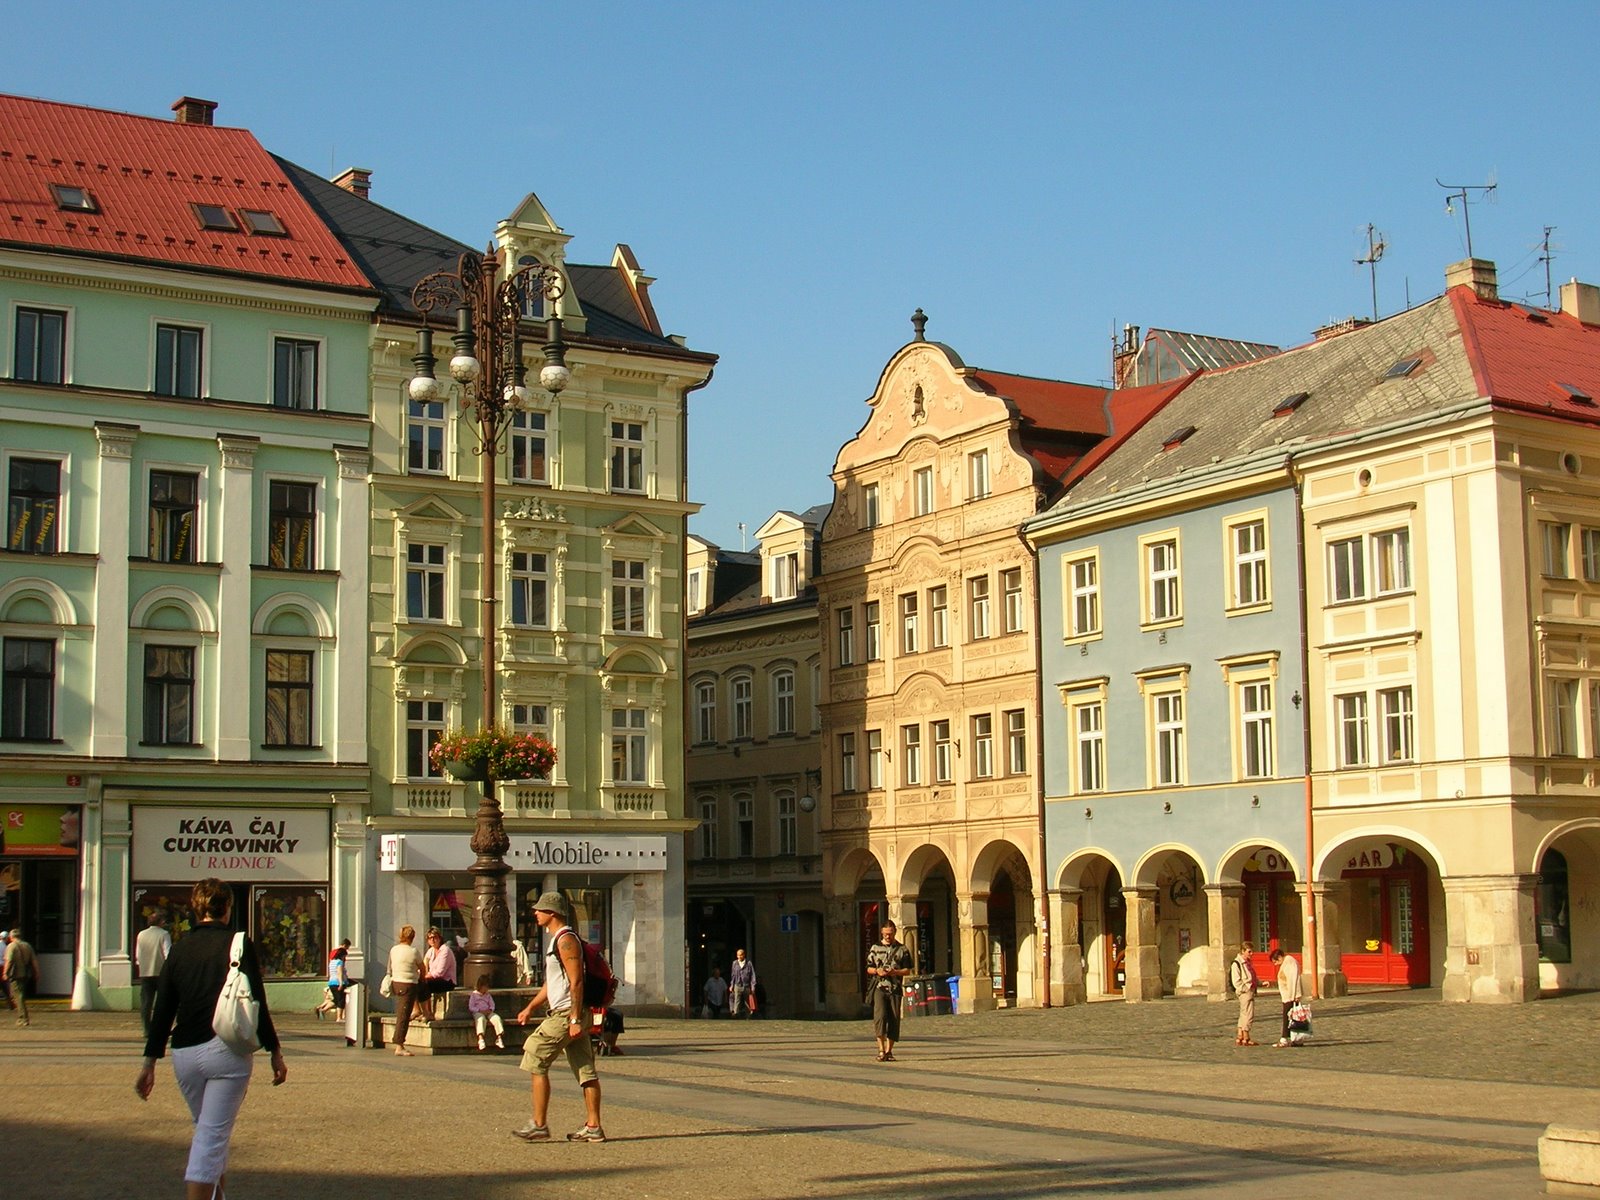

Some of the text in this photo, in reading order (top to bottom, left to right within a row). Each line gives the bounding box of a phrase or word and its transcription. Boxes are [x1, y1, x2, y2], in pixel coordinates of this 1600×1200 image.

[179, 816, 286, 839] KÁVA ČAJ
[163, 838, 300, 853] CUKROVINKY
[387, 840, 396, 865] T
[532, 841, 602, 865] Mobile
[190, 856, 276, 869] U RADNICE
